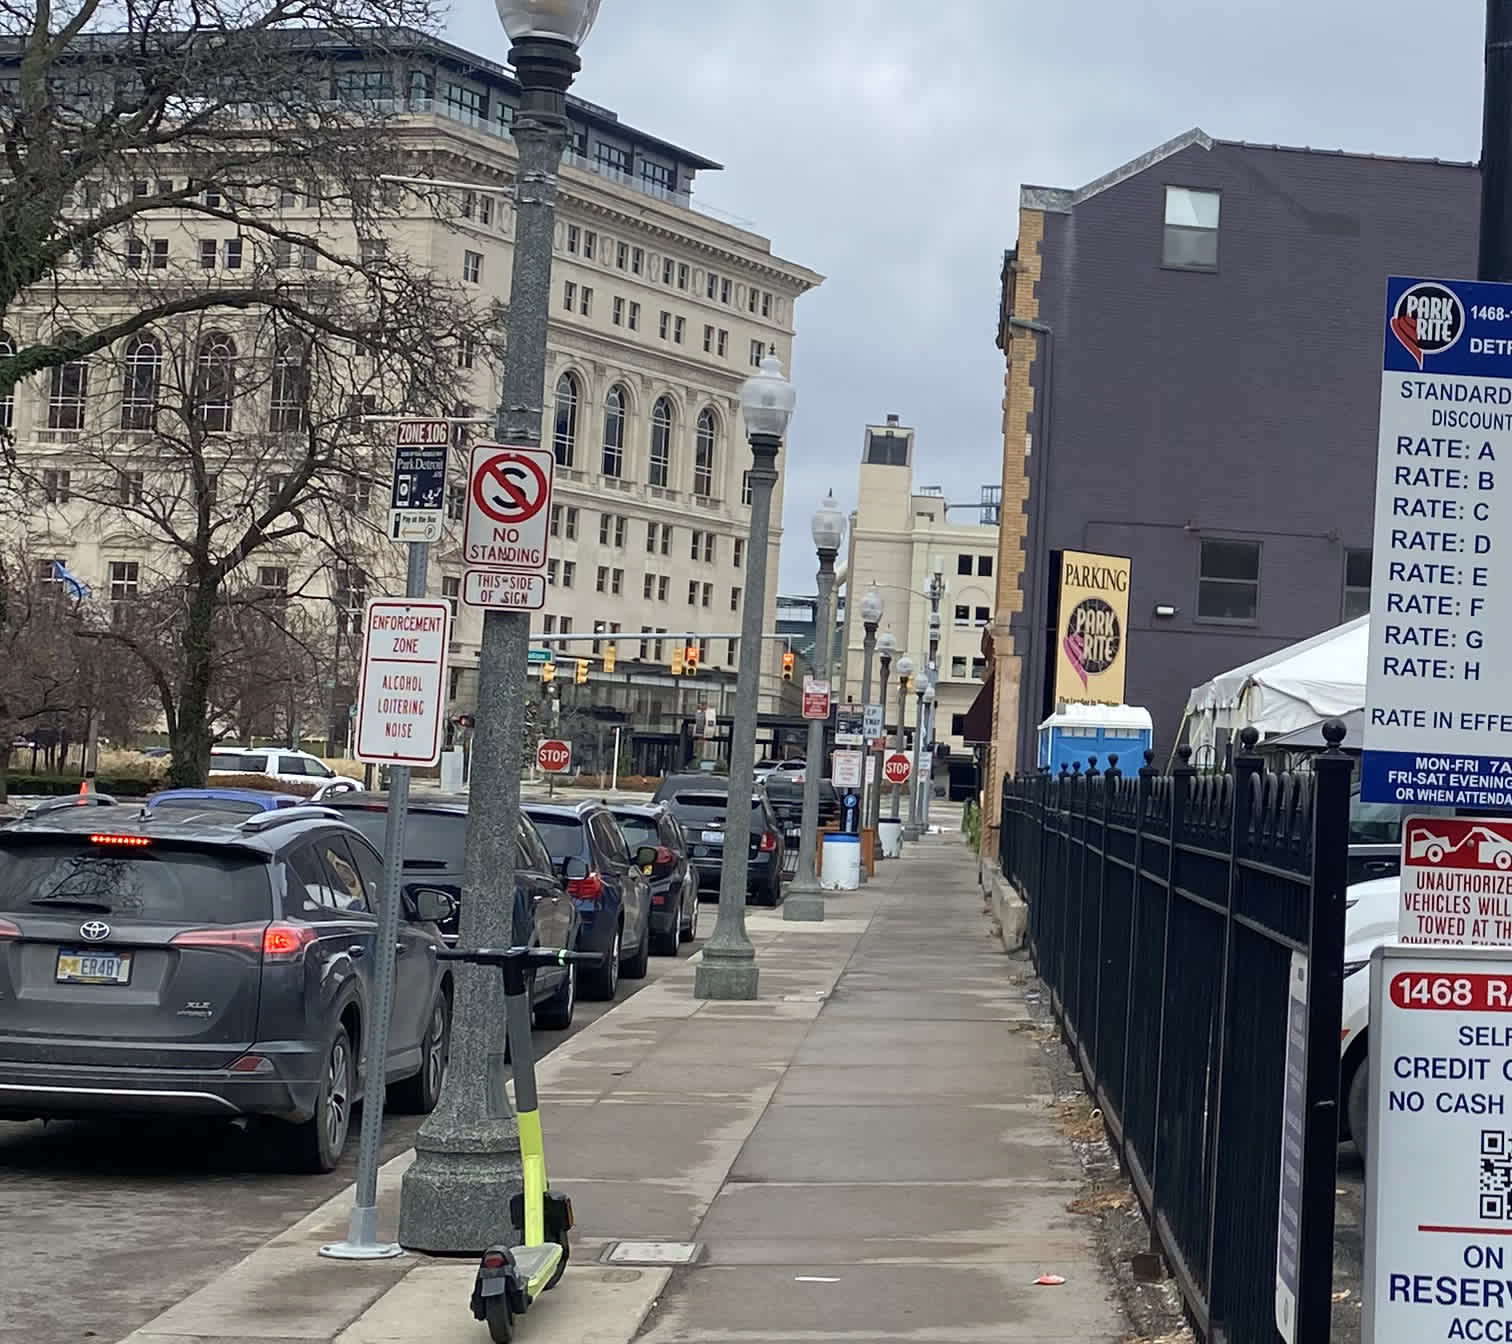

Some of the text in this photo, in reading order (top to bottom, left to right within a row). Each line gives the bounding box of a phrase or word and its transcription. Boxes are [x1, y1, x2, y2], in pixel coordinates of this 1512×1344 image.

[1406, 295, 1454, 320] PARK
[1416, 317, 1452, 342] RITE
[1400, 380, 1512, 405] STANDARD
[400, 422, 448, 443] ZONE 106
[1396, 436, 1470, 460] RATE:
[1478, 442, 1496, 461] A
[1394, 466, 1469, 489] RATE:
[1478, 471, 1495, 490] B
[1392, 497, 1464, 520] RATE:
[1473, 503, 1489, 522] C
[492, 527, 519, 543] NO
[1391, 529, 1465, 553] RATE:
[1474, 534, 1491, 554] D
[470, 544, 540, 564] STANDING
[477, 574, 534, 590] THIS SIDE
[1064, 563, 1128, 592] PARKING
[1388, 561, 1463, 586] RATE:
[1472, 567, 1488, 587] E
[480, 590, 528, 605] OF SIGN
[1386, 593, 1461, 616] RATE:
[1470, 597, 1485, 617] F
[372, 615, 441, 632] ENFORCEMENT
[1076, 608, 1115, 637] PARK
[392, 637, 418, 654] ZONE
[1083, 635, 1114, 662] RITE
[1384, 625, 1457, 649] RATE:
[1465, 630, 1483, 649] G
[1383, 656, 1455, 679] RATE:
[1464, 661, 1480, 681] H
[382, 675, 423, 692] ALCOHOL
[378, 698, 424, 716] LOITERING
[1371, 708, 1426, 728] RATE
[1433, 711, 1453, 729] IN
[385, 723, 413, 738] NOISE
[540, 749, 569, 763] STOP
[1415, 757, 1479, 773] MON-FRI
[886, 765, 910, 775] STOP
[1388, 770, 1446, 786] FRI-SAT
[1395, 788, 1415, 801] OR
[1417, 789, 1454, 803] WHEN
[1404, 892, 1471, 915] VEHICLES
[1478, 898, 1511, 918] WILL
[1416, 915, 1465, 937] TOWED
[1471, 919, 1491, 939] AT
[1398, 977, 1473, 1006] 1468
[1393, 1056, 1491, 1081] CREDIT
[1388, 1091, 1424, 1113] NO
[1435, 1092, 1505, 1115] CASH
[1463, 1245, 1504, 1270] ON
